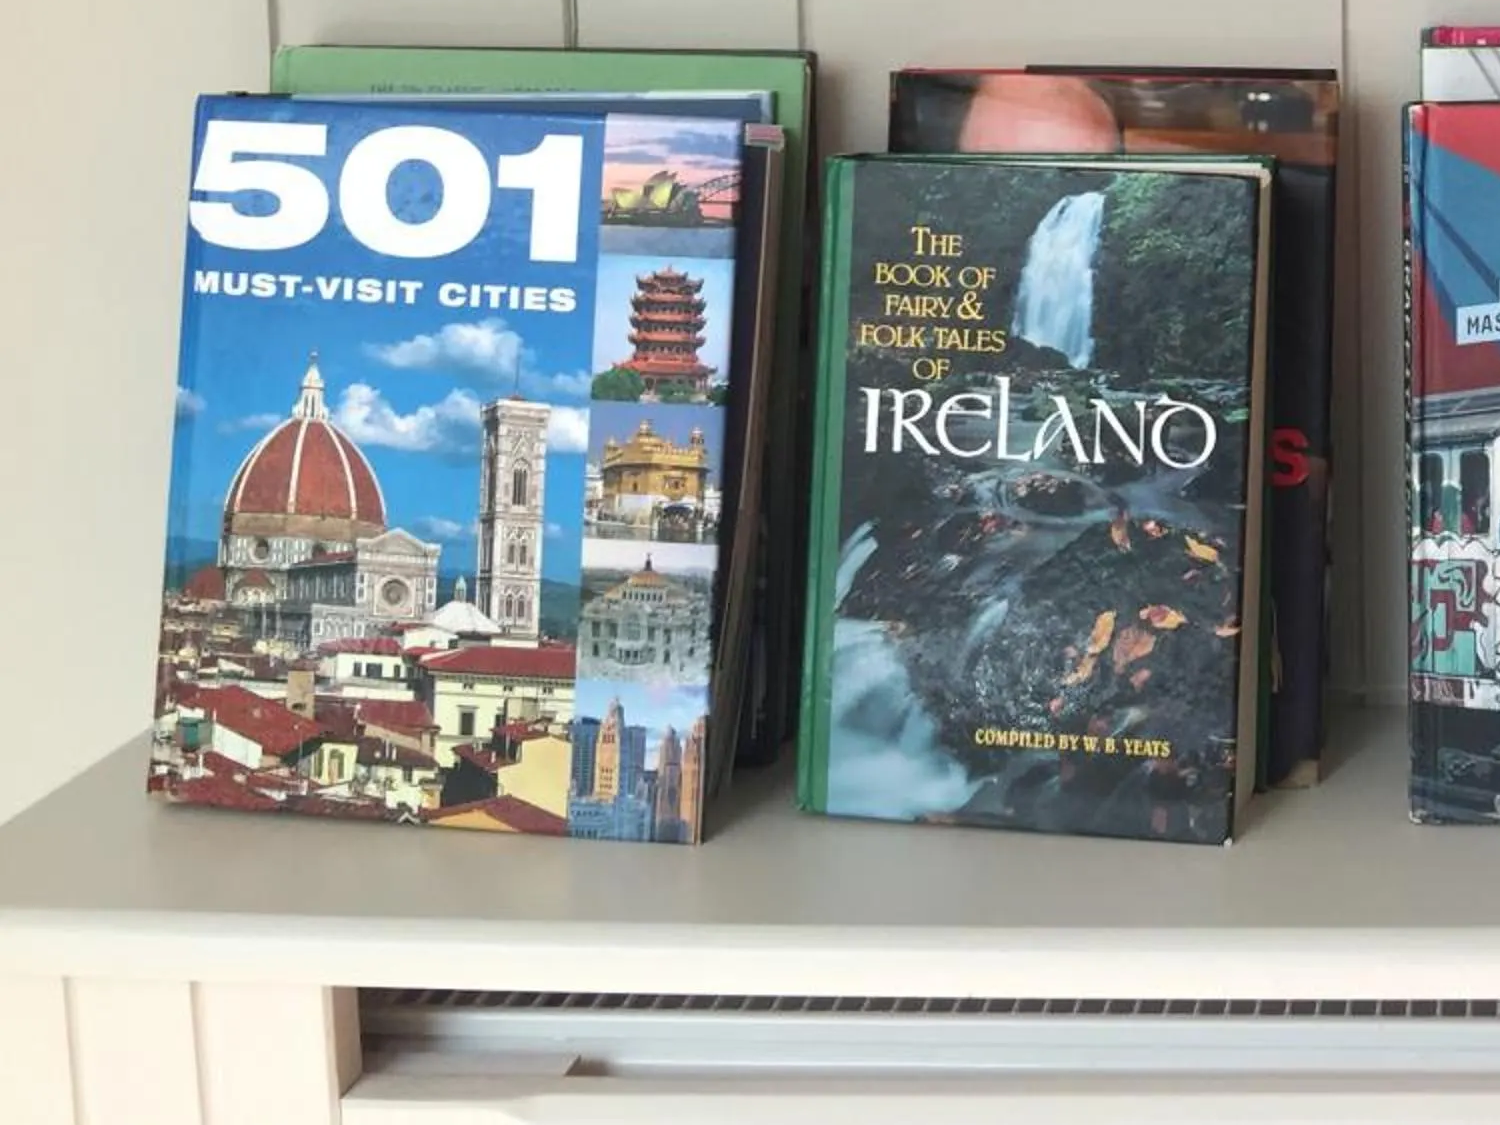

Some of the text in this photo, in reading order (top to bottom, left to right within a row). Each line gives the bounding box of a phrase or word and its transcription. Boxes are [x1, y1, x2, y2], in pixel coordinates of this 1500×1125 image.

[189, 120, 584, 263] 501
[193, 269, 577, 313] MUST-VISIT CITIES
[875, 262, 997, 290] BOOK OF
[884, 290, 985, 320] FAIRY &
[860, 323, 1007, 353] FOLK TALES
[912, 356, 951, 380] OF
[859, 376, 1218, 469] IRELAND
[974, 728, 1056, 750] COMPILED
[1058, 733, 1080, 751] BY
[1122, 737, 1172, 759] YEATS
